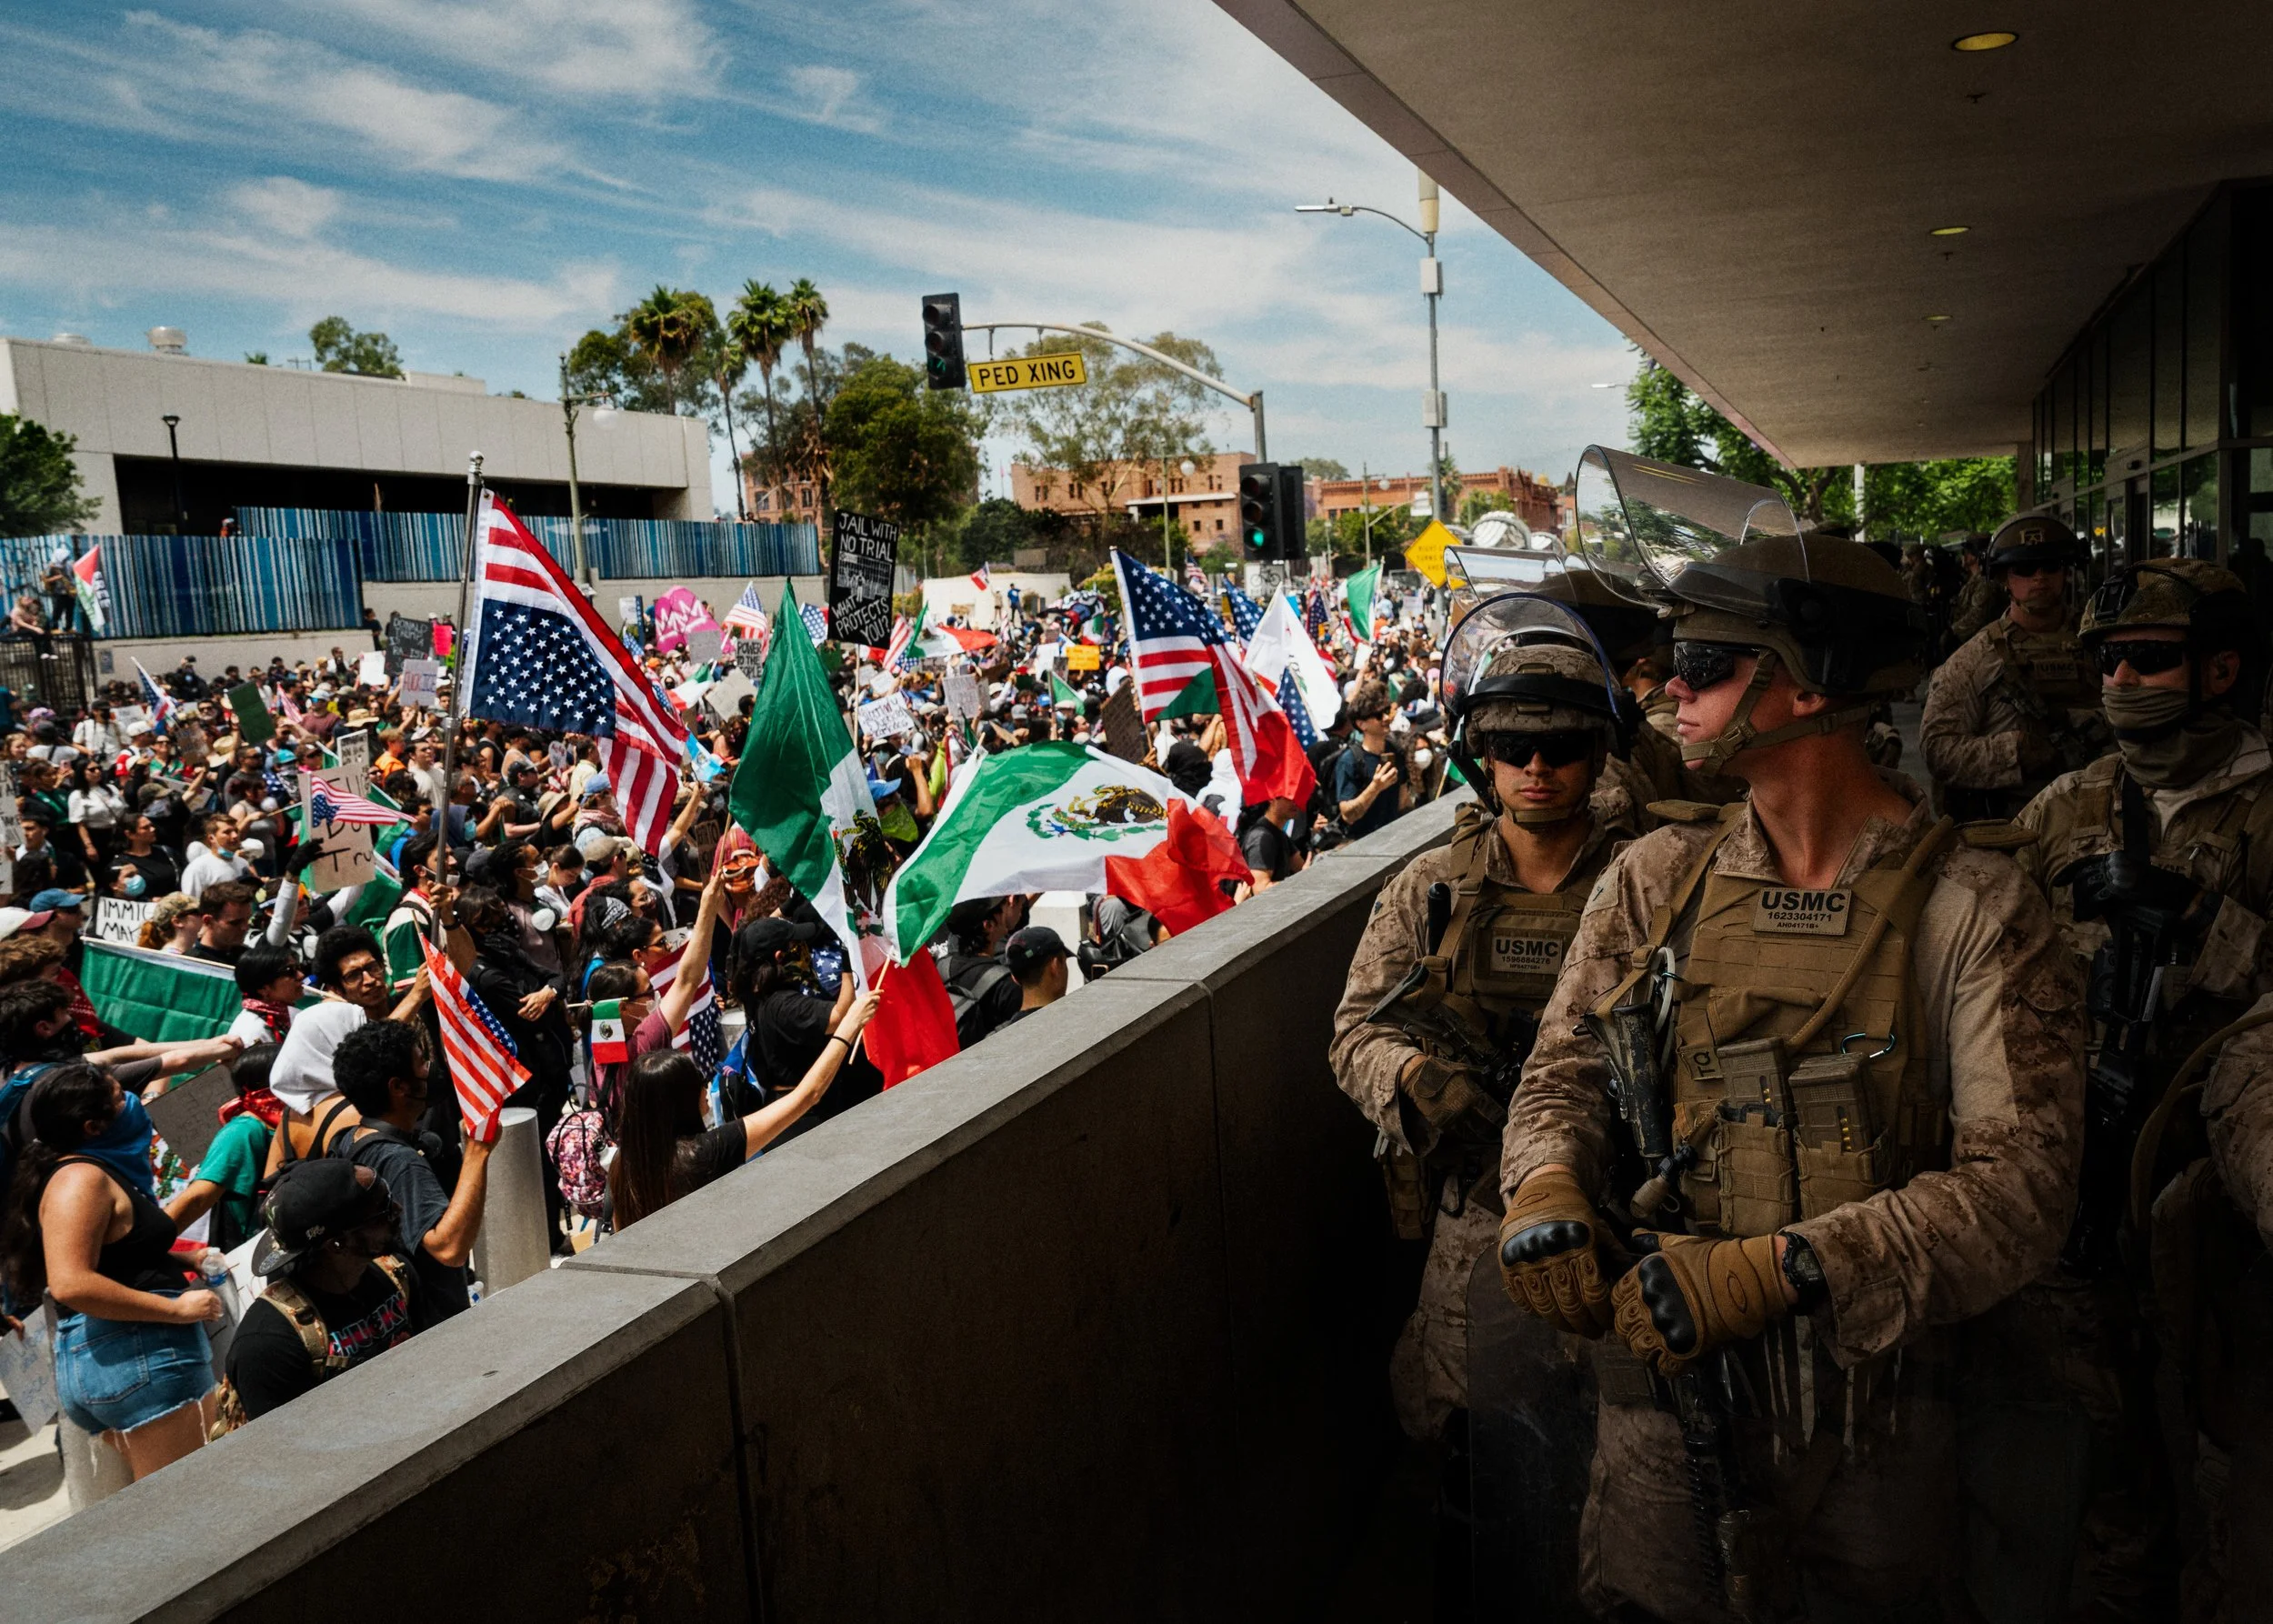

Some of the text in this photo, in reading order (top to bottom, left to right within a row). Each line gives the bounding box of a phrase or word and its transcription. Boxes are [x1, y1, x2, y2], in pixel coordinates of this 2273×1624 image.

[978, 360, 1075, 386] PED XING
[839, 513, 897, 541] JAIL WITH
[840, 533, 893, 562] NO TRIAL
[832, 596, 856, 618] WHAT
[836, 596, 889, 638] PROTECTS
[860, 615, 890, 646] YOU?
[393, 646, 425, 659] RAIST
[737, 641, 762, 655] POWER
[736, 656, 760, 665] TO THE
[2040, 663, 2075, 672] USMC
[1762, 891, 1846, 912] USMC
[1767, 912, 1832, 922] 1623304171
[1496, 939, 1558, 957] USMC
[1693, 1051, 1716, 1078] TQ
